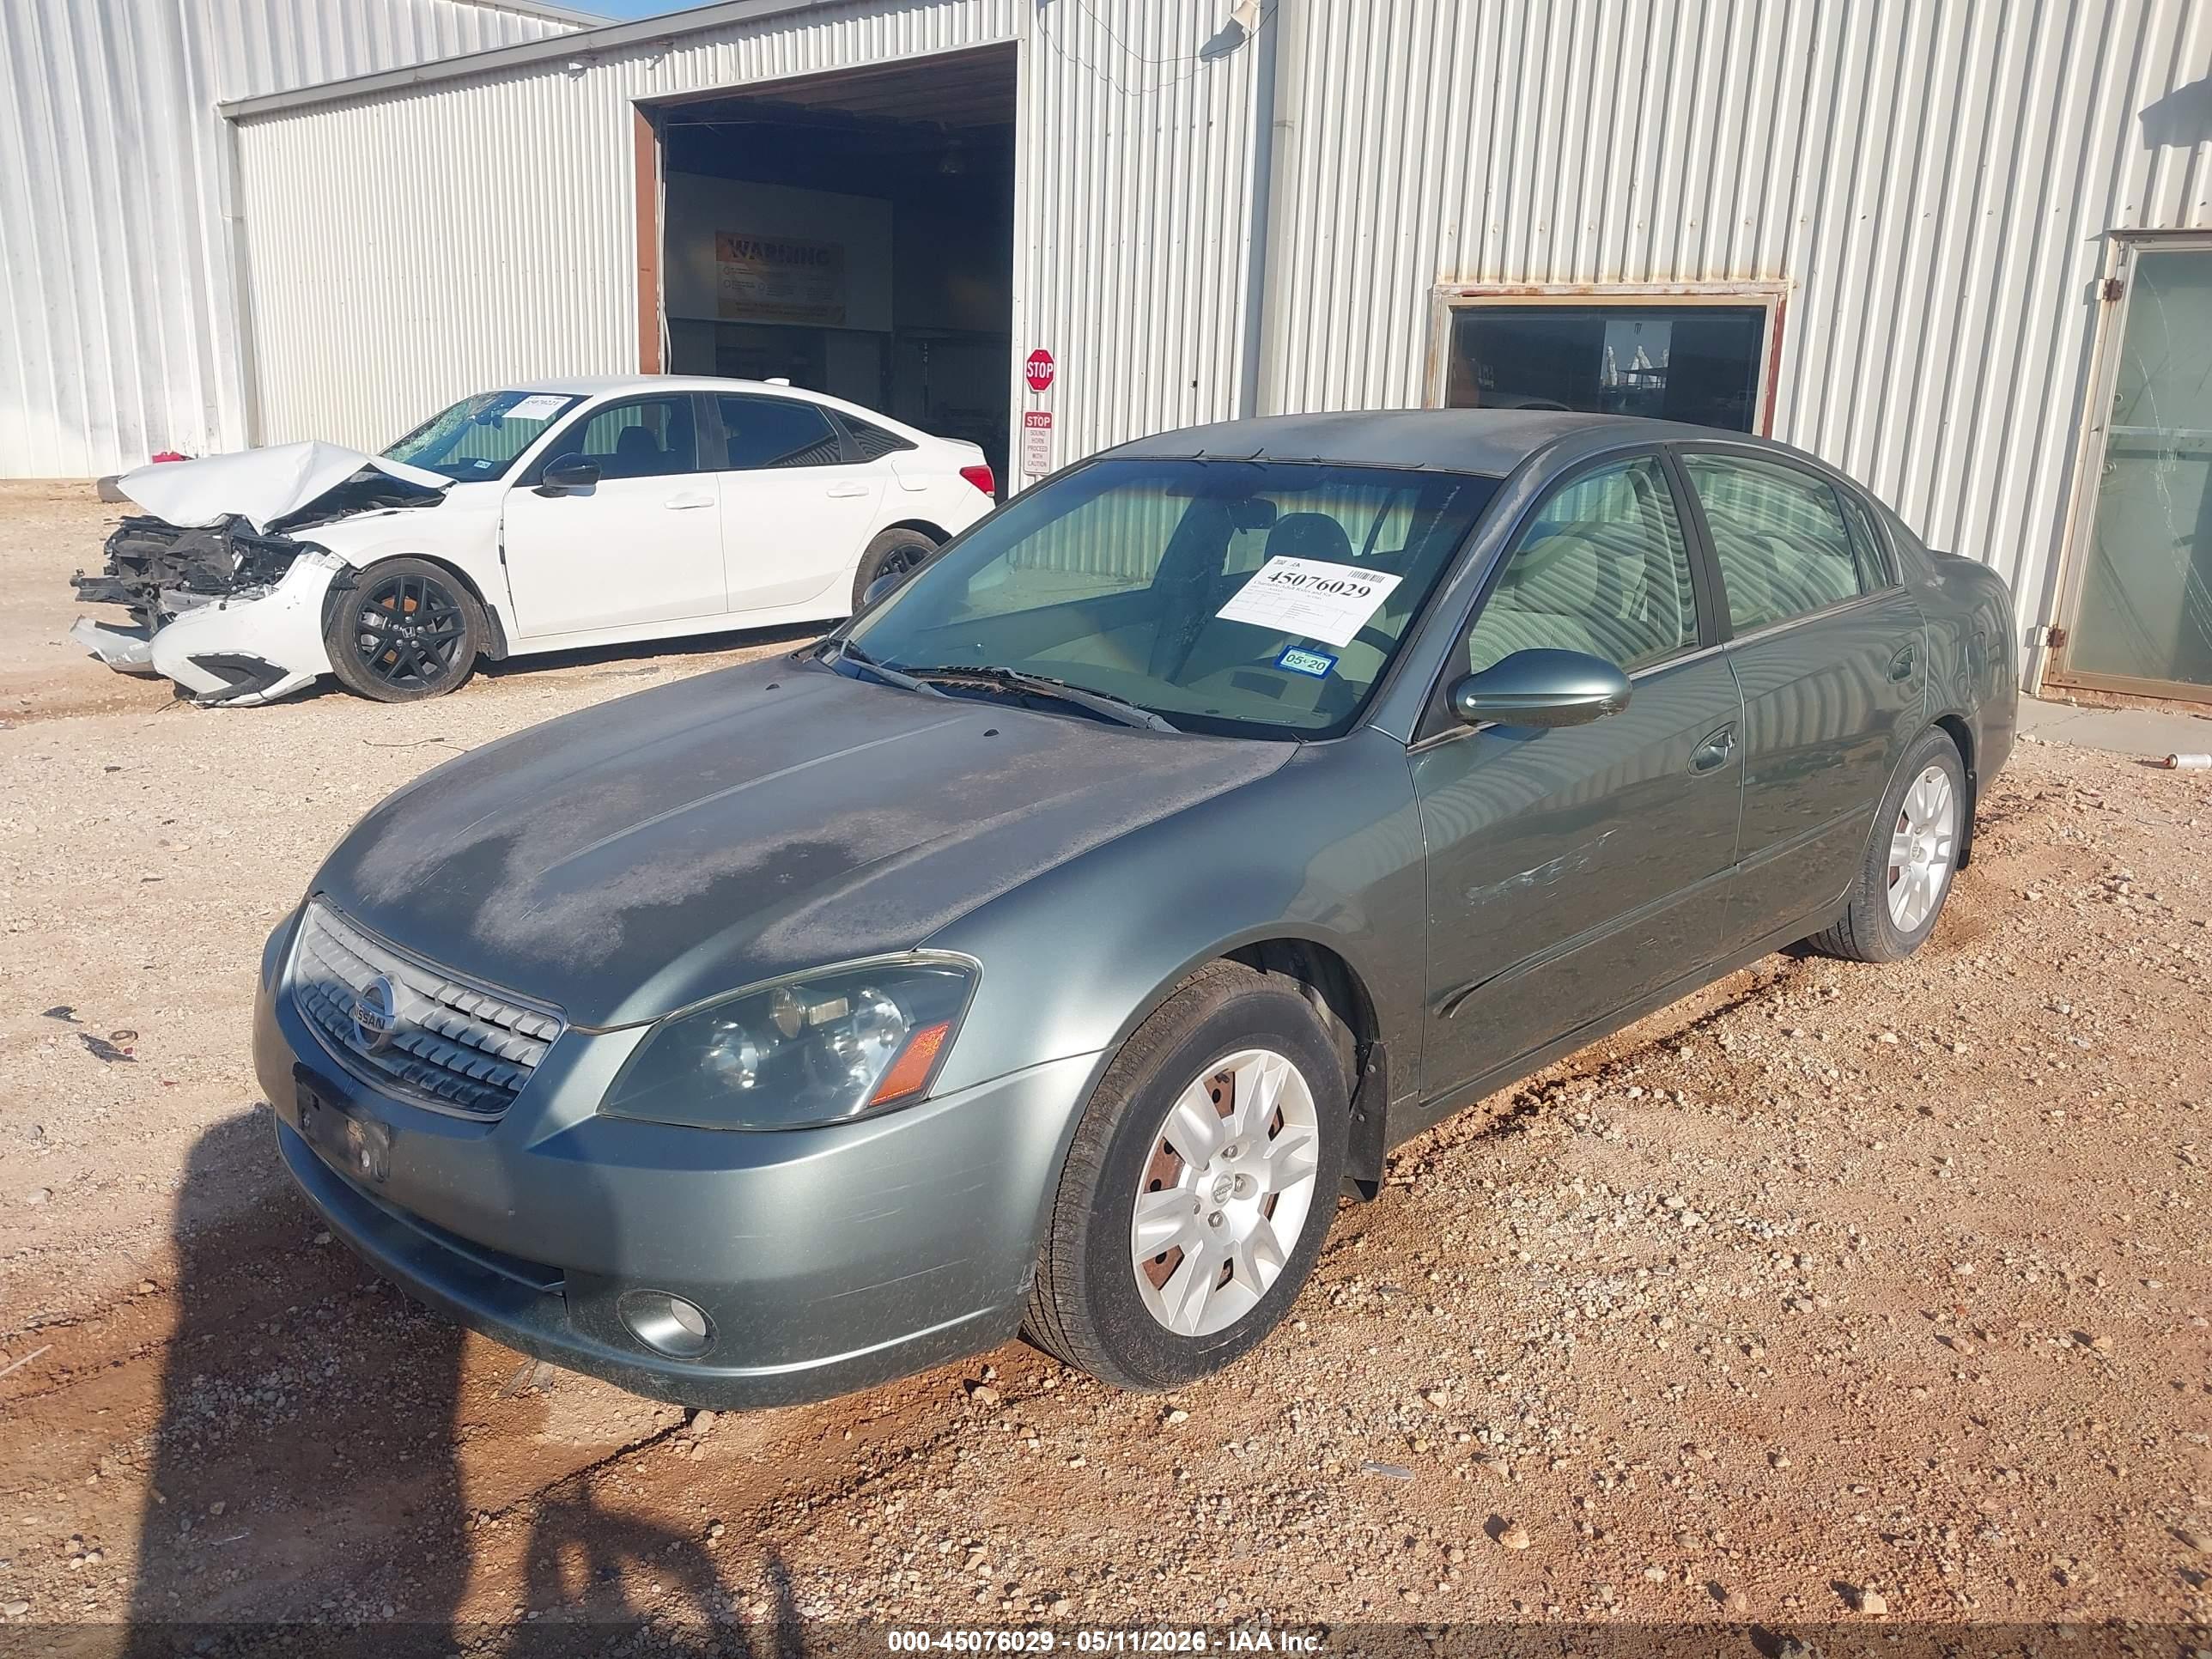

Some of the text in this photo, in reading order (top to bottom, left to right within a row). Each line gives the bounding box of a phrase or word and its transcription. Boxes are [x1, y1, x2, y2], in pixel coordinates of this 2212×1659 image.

[728, 239, 831, 265] WARNING
[1027, 362, 1054, 379] STOP
[1026, 416, 1050, 427] STOP
[1267, 570, 1371, 599] 45076029
[1286, 654, 1326, 671] 05 20
